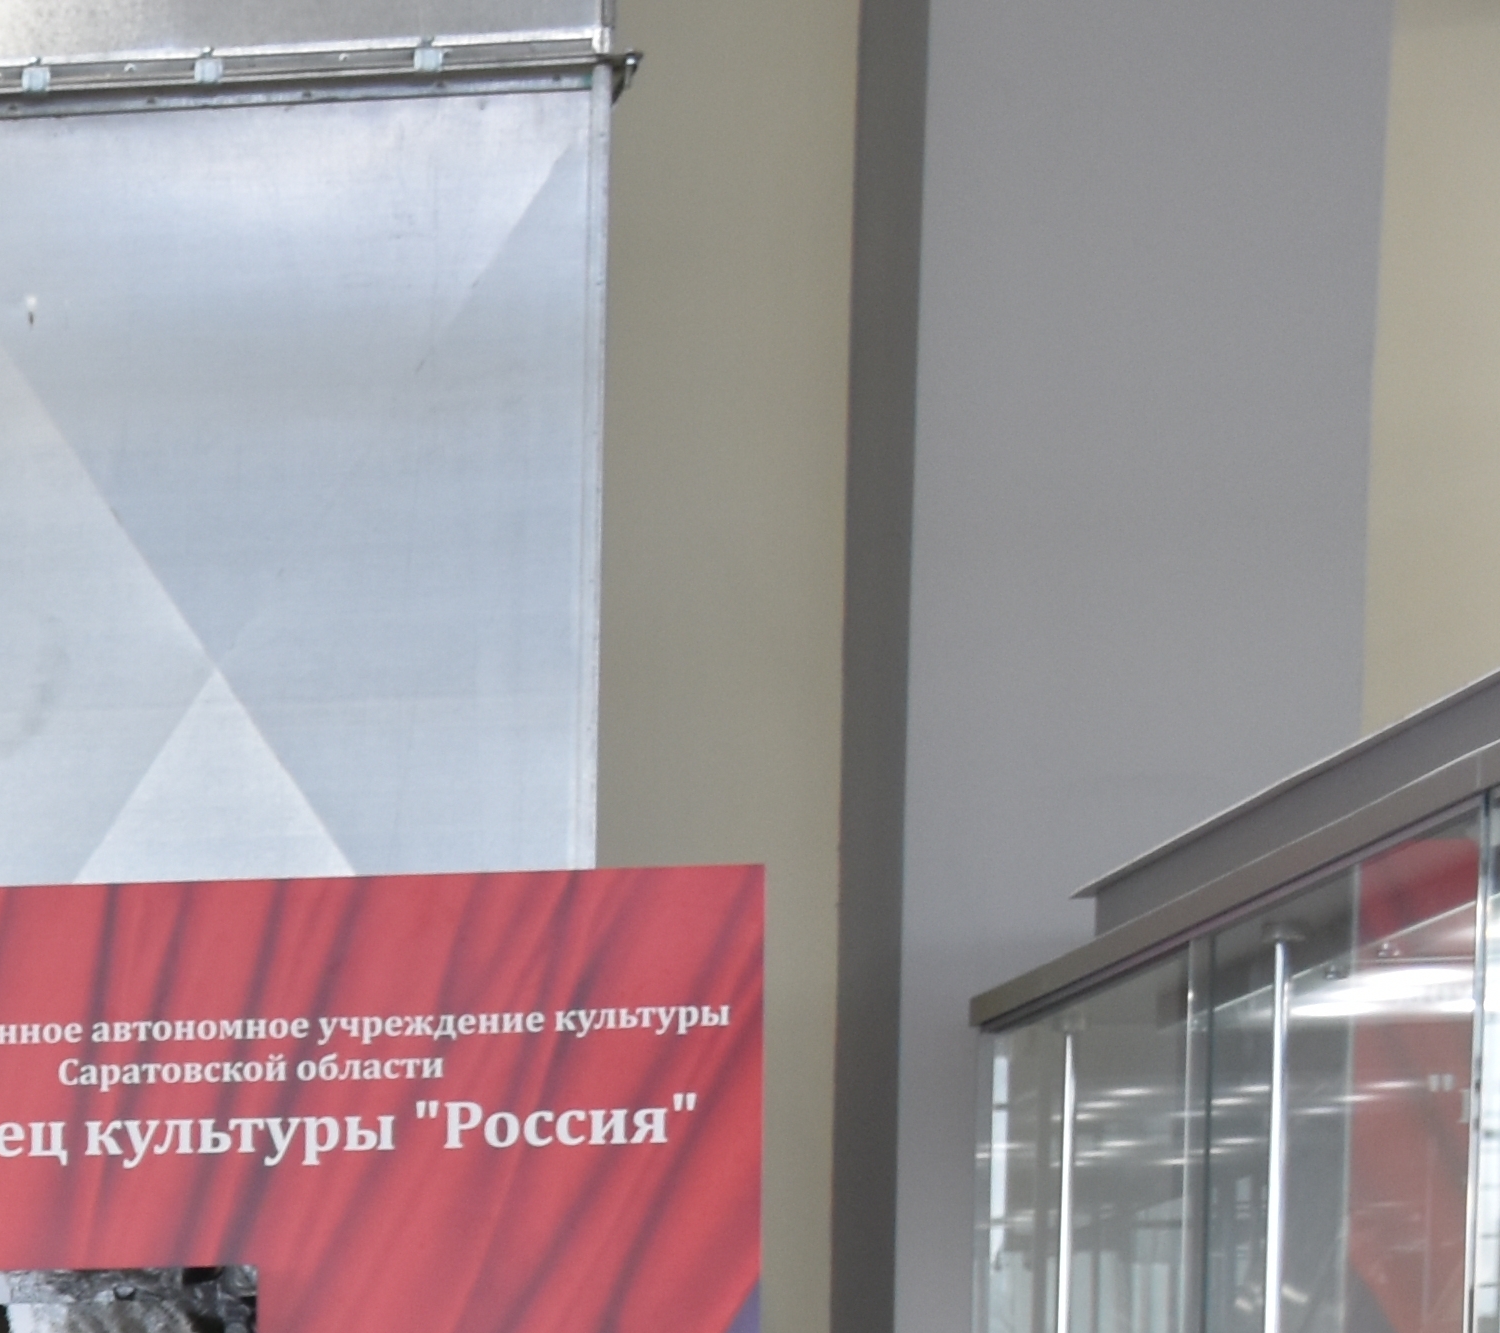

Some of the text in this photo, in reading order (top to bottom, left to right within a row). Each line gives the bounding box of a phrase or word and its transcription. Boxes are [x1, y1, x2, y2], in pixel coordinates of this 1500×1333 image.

[91, 1016, 310, 1043] автономное
[317, 1010, 545, 1047] учреждение
[555, 1003, 730, 1039] культуры
[58, 1043, 444, 1091] Саратовской области
[84, 1113, 395, 1169] культуры
[415, 1092, 697, 1150] "Россия"
